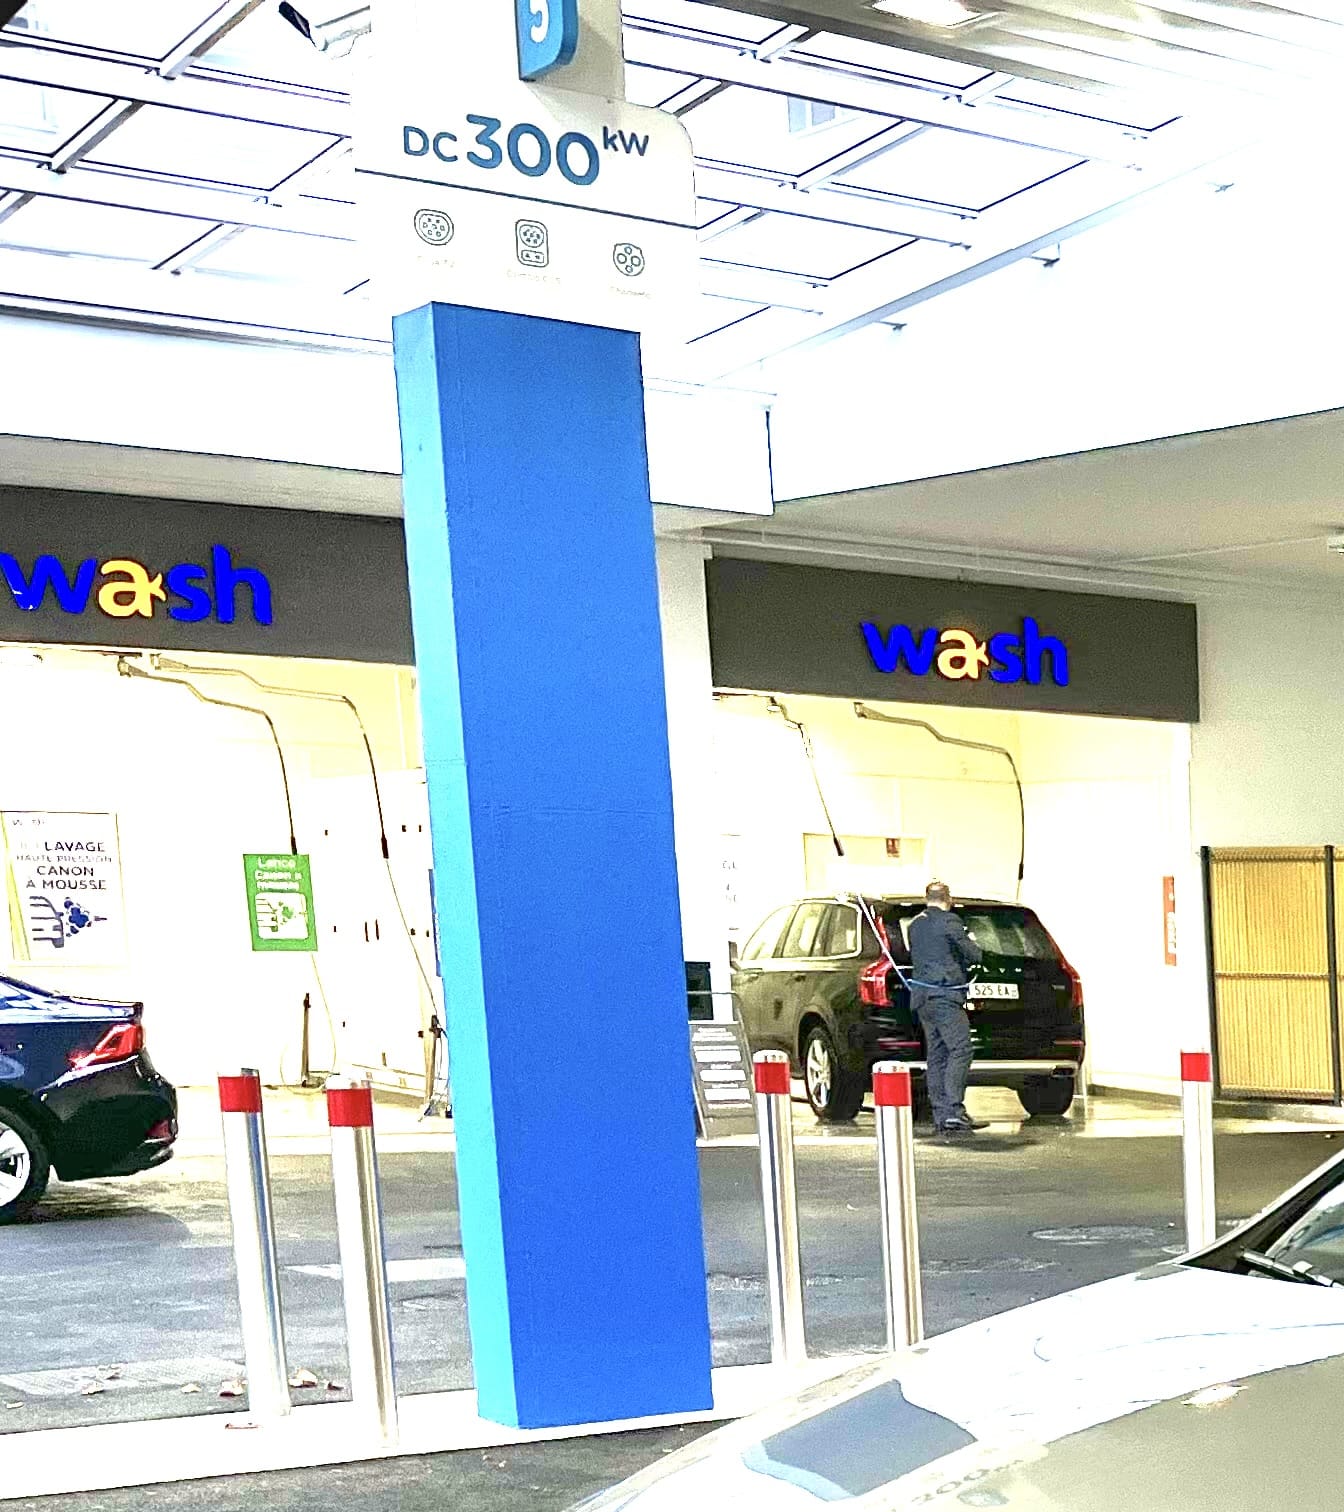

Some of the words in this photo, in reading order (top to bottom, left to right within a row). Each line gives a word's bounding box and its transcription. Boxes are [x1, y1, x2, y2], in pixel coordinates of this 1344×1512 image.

[0, 544, 272, 625] wash
[860, 616, 1070, 687] wash
[44, 841, 105, 852] LAVAGE
[36, 865, 94, 877] CANON
[42, 879, 107, 890] MOUSSE
